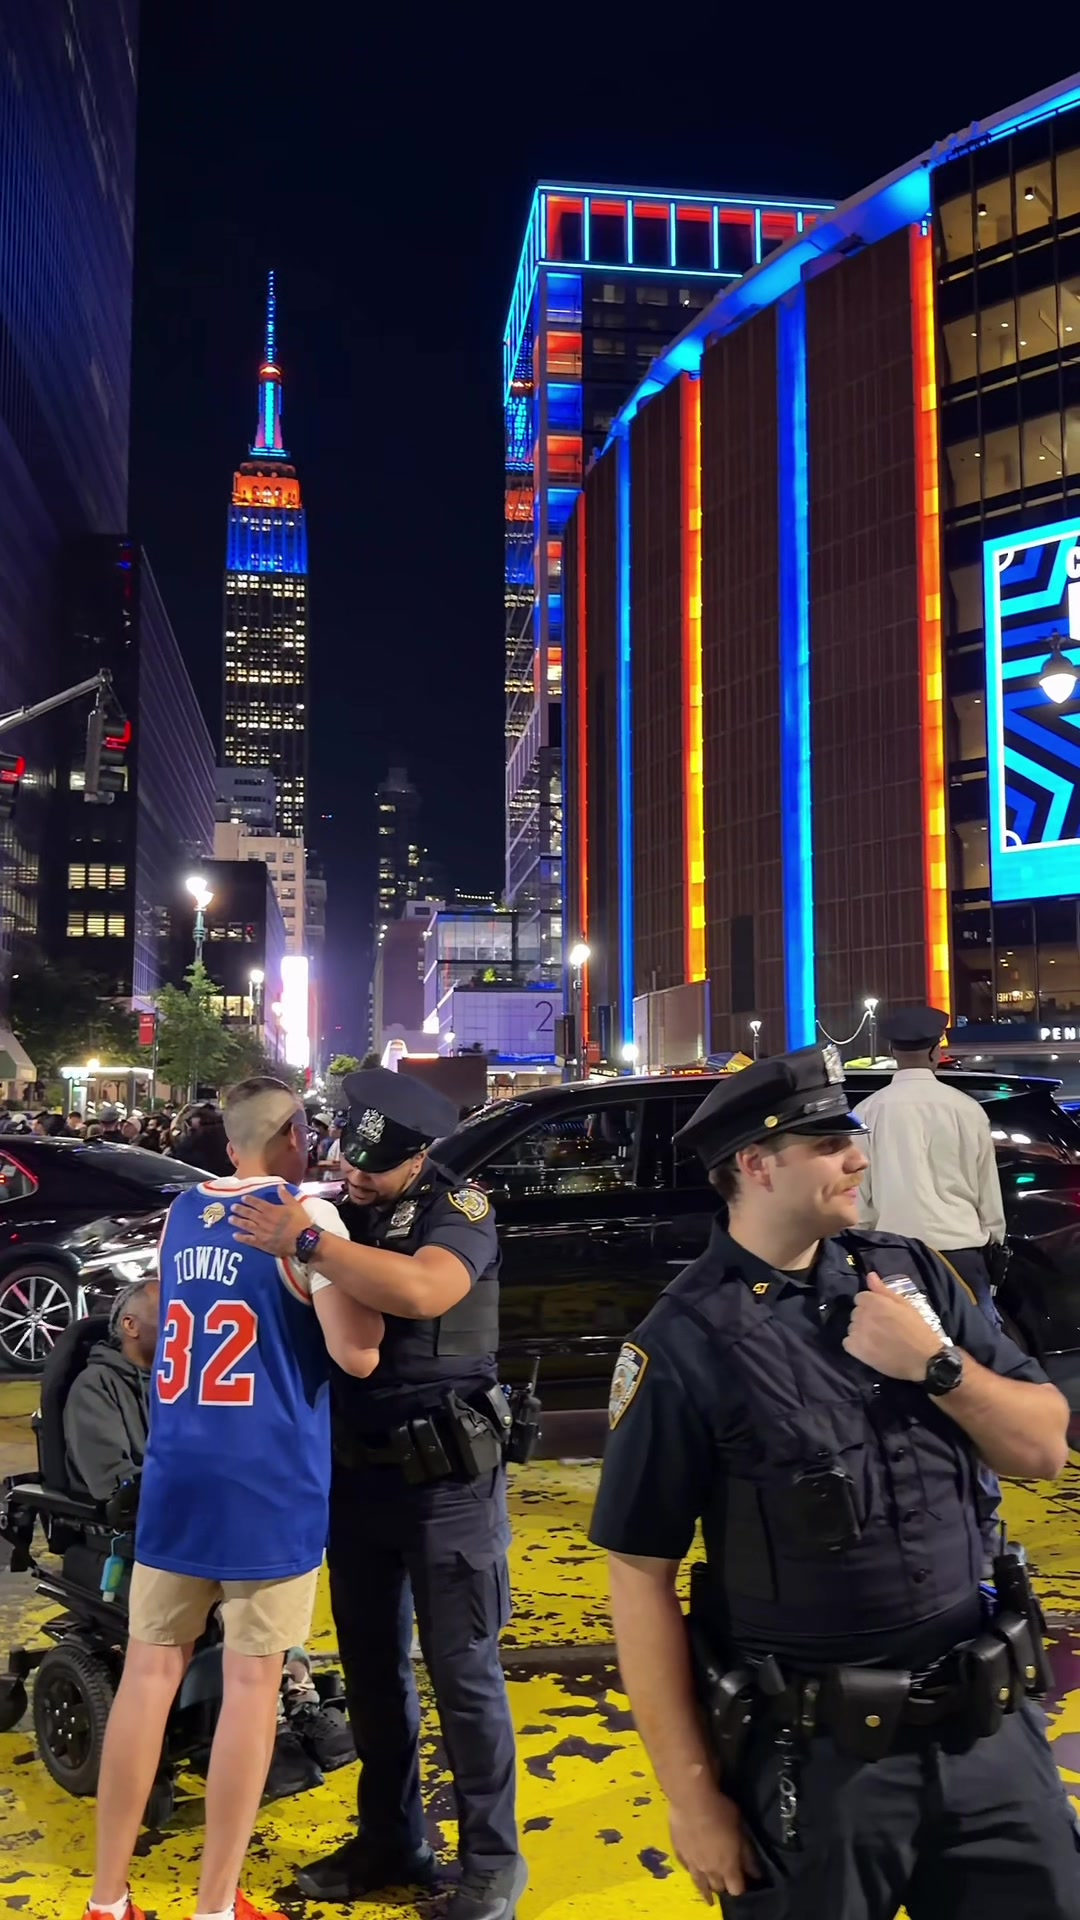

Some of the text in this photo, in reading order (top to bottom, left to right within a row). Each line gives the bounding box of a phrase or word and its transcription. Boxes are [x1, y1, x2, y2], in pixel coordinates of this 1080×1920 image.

[535, 1001, 553, 1032] 2
[1041, 1028, 1080, 1041] PEN
[174, 1246, 243, 1286] TOWNS
[156, 1299, 258, 1406] 32
